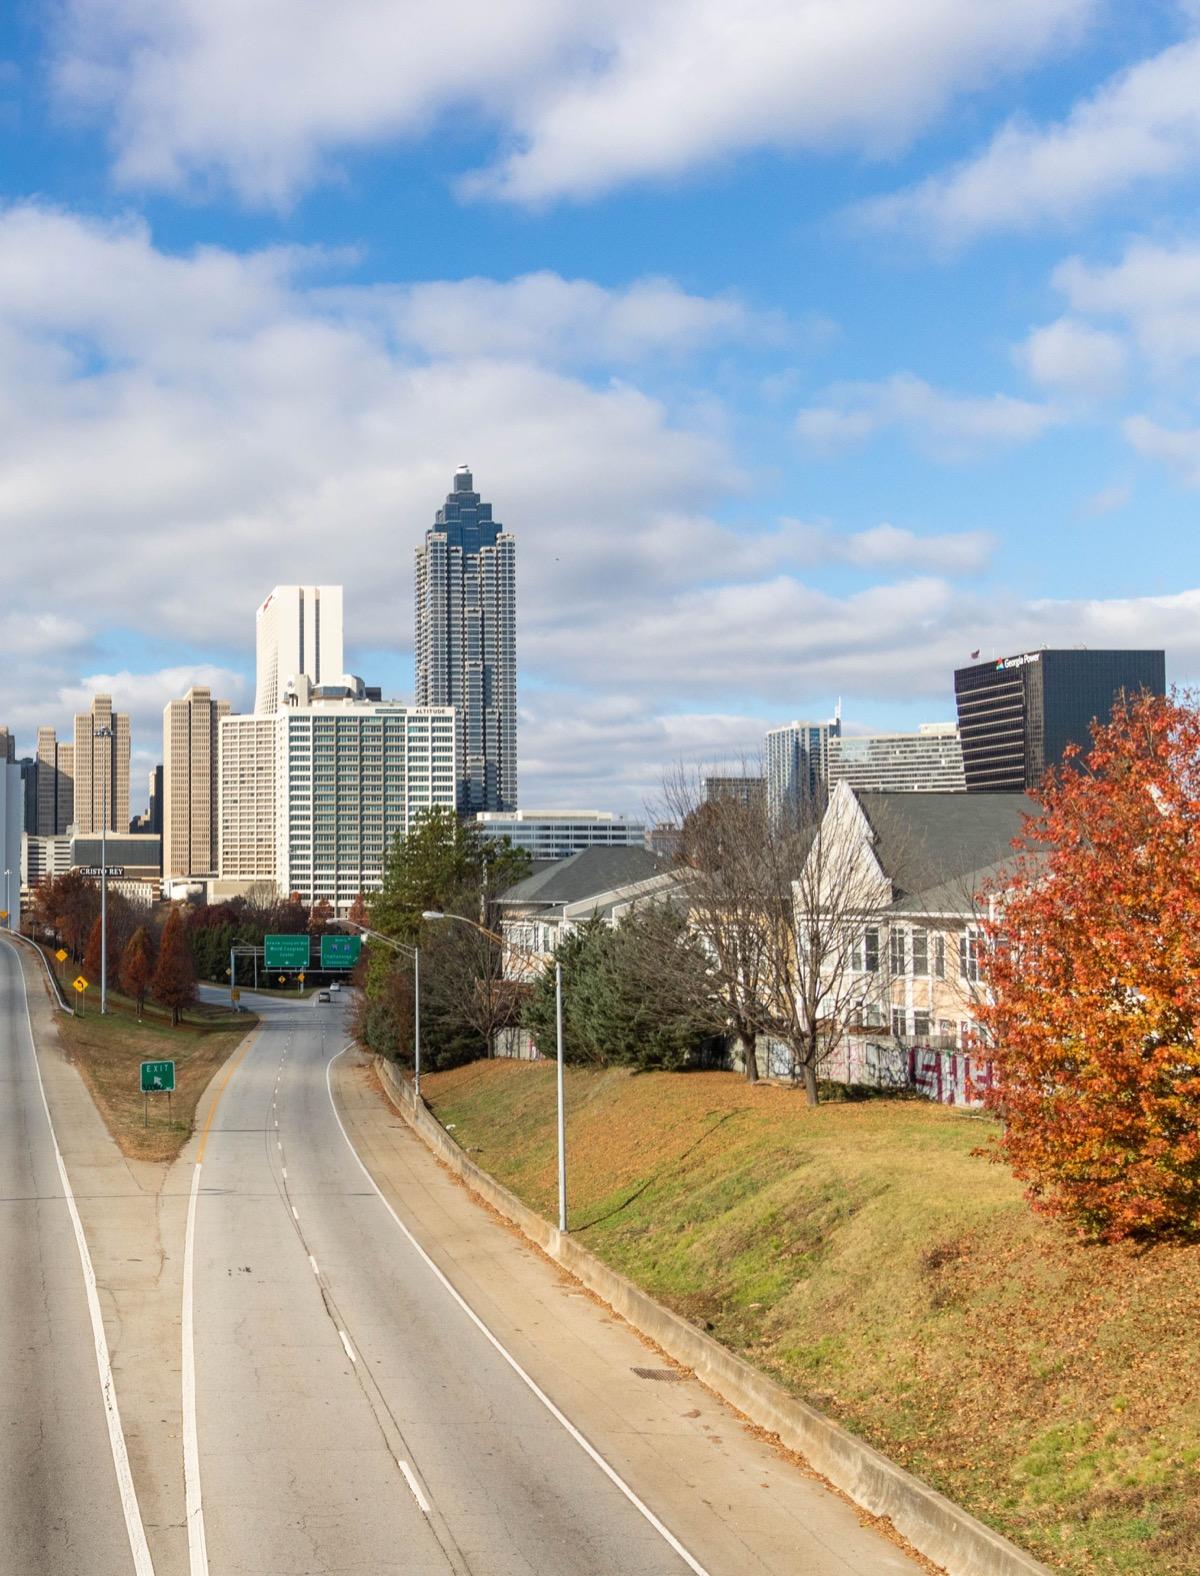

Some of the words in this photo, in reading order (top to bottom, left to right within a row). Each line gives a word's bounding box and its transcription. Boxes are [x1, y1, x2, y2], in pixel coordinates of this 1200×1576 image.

[1005, 656, 1023, 669] Georgia
[1024, 653, 1039, 664] Power
[146, 1064, 169, 1072] EXIT
